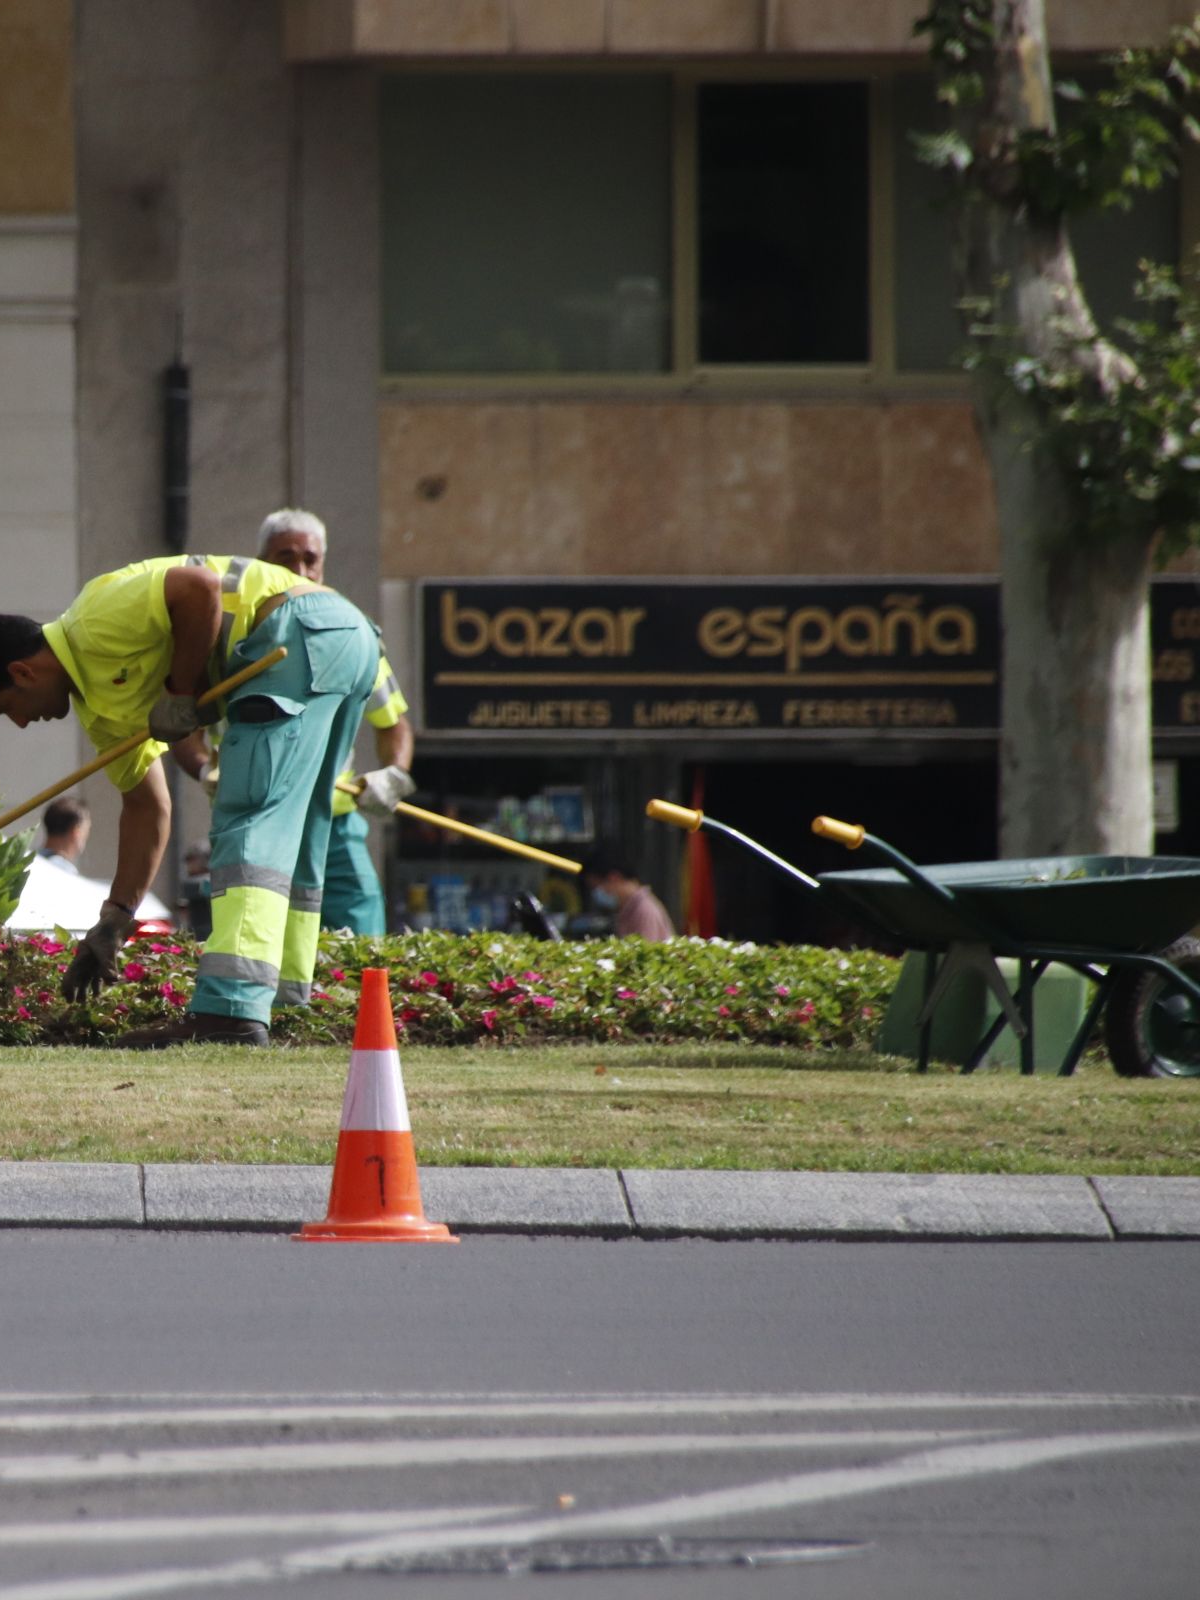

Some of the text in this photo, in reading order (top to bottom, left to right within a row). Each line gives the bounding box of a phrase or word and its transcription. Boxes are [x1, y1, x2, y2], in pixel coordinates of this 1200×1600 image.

[441, 590, 976, 673] bazar españa
[469, 701, 956, 726] JUGUETES LIMPIEZA FERRETERIA
